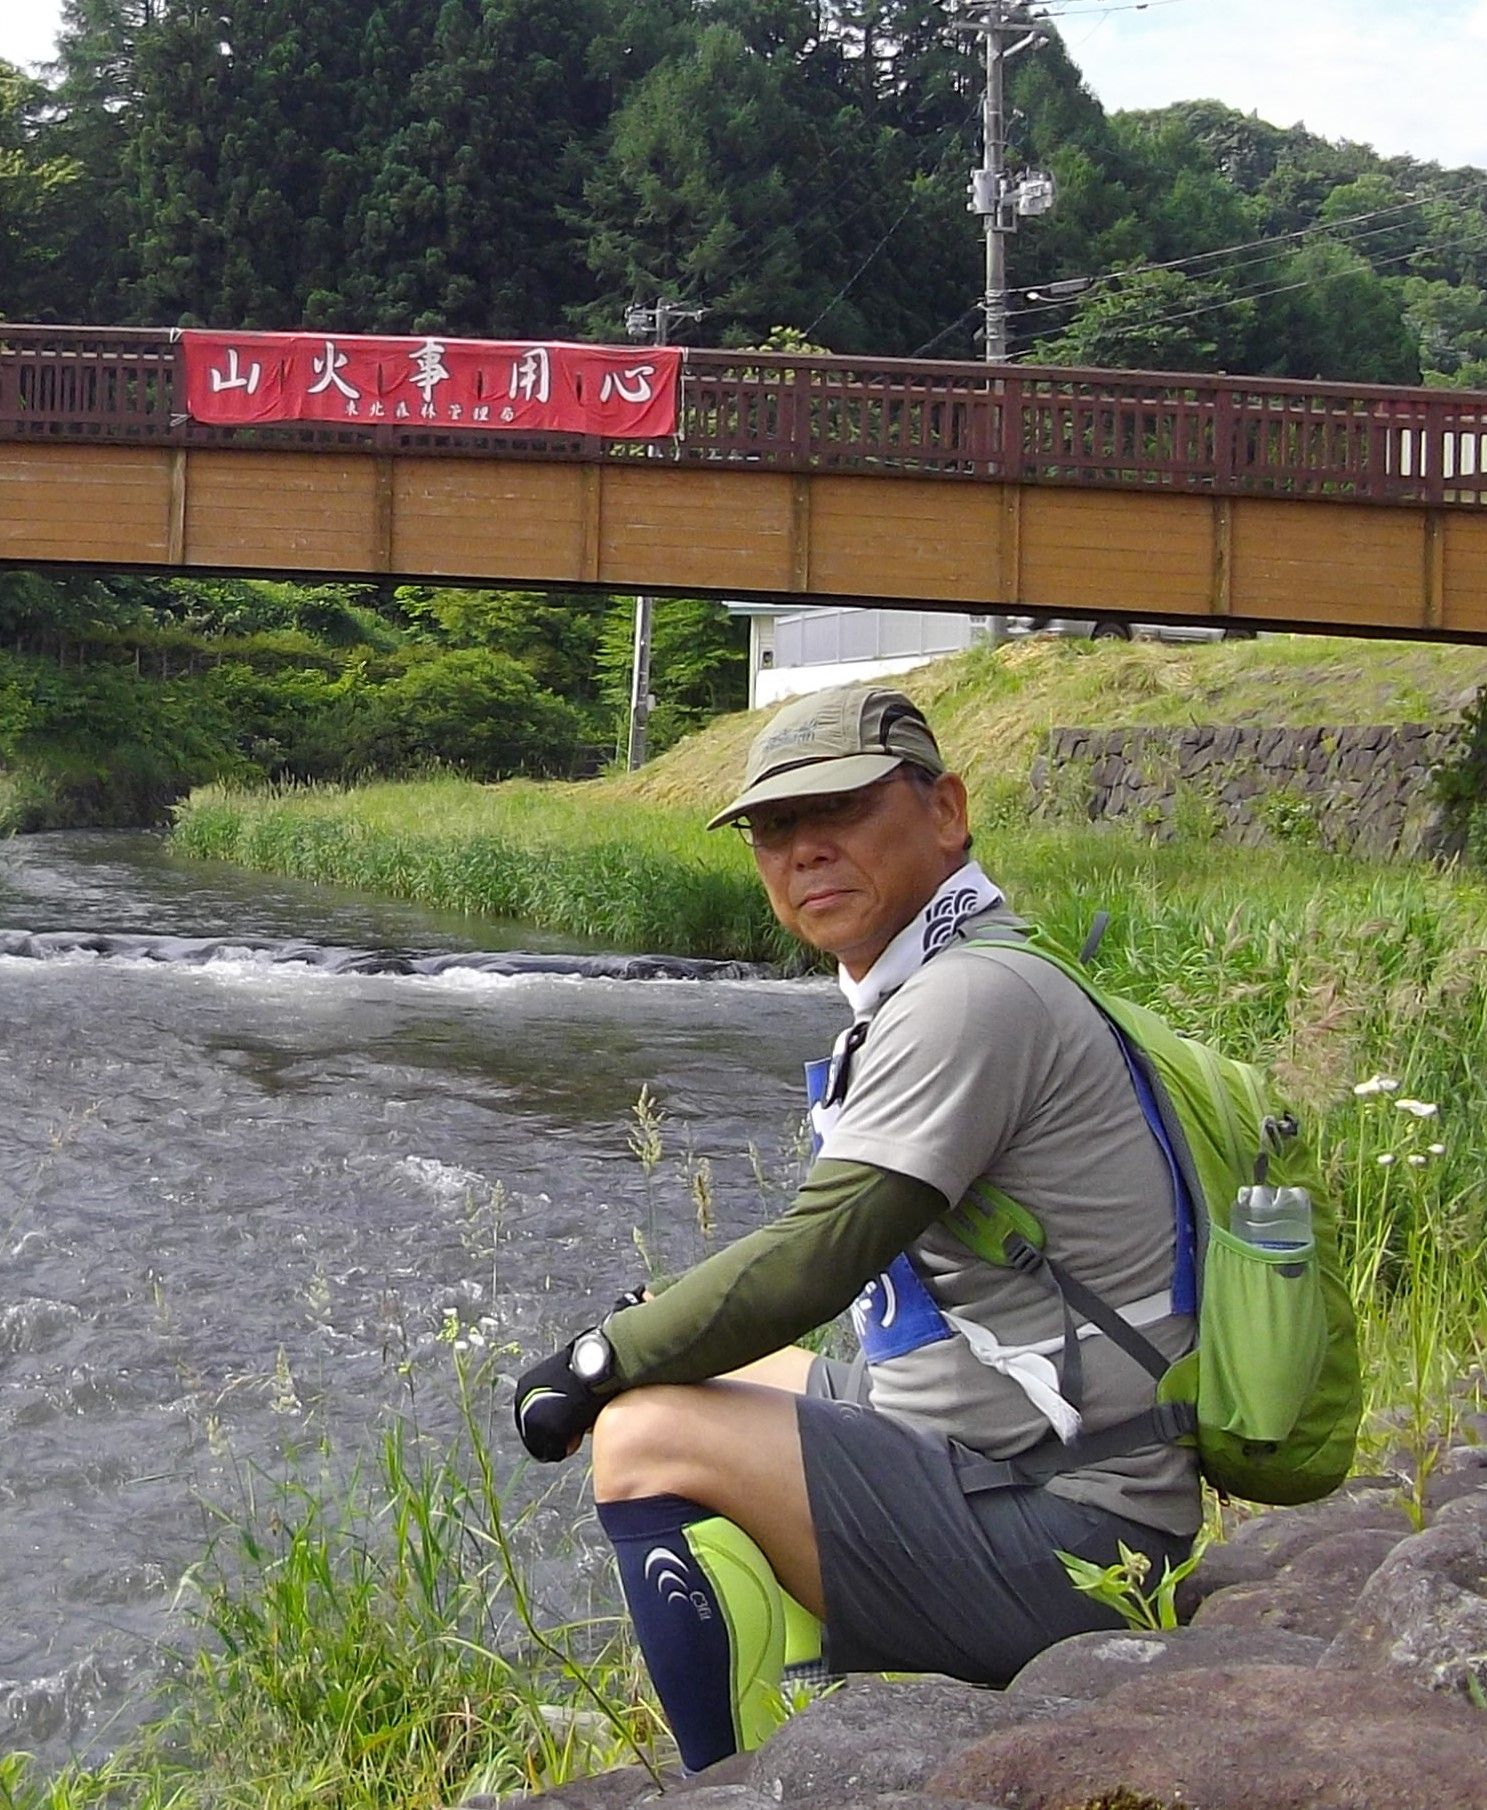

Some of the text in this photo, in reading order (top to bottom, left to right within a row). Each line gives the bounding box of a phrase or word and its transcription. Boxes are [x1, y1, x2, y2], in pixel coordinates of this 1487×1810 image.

[211, 339, 655, 404] 山火事用心
